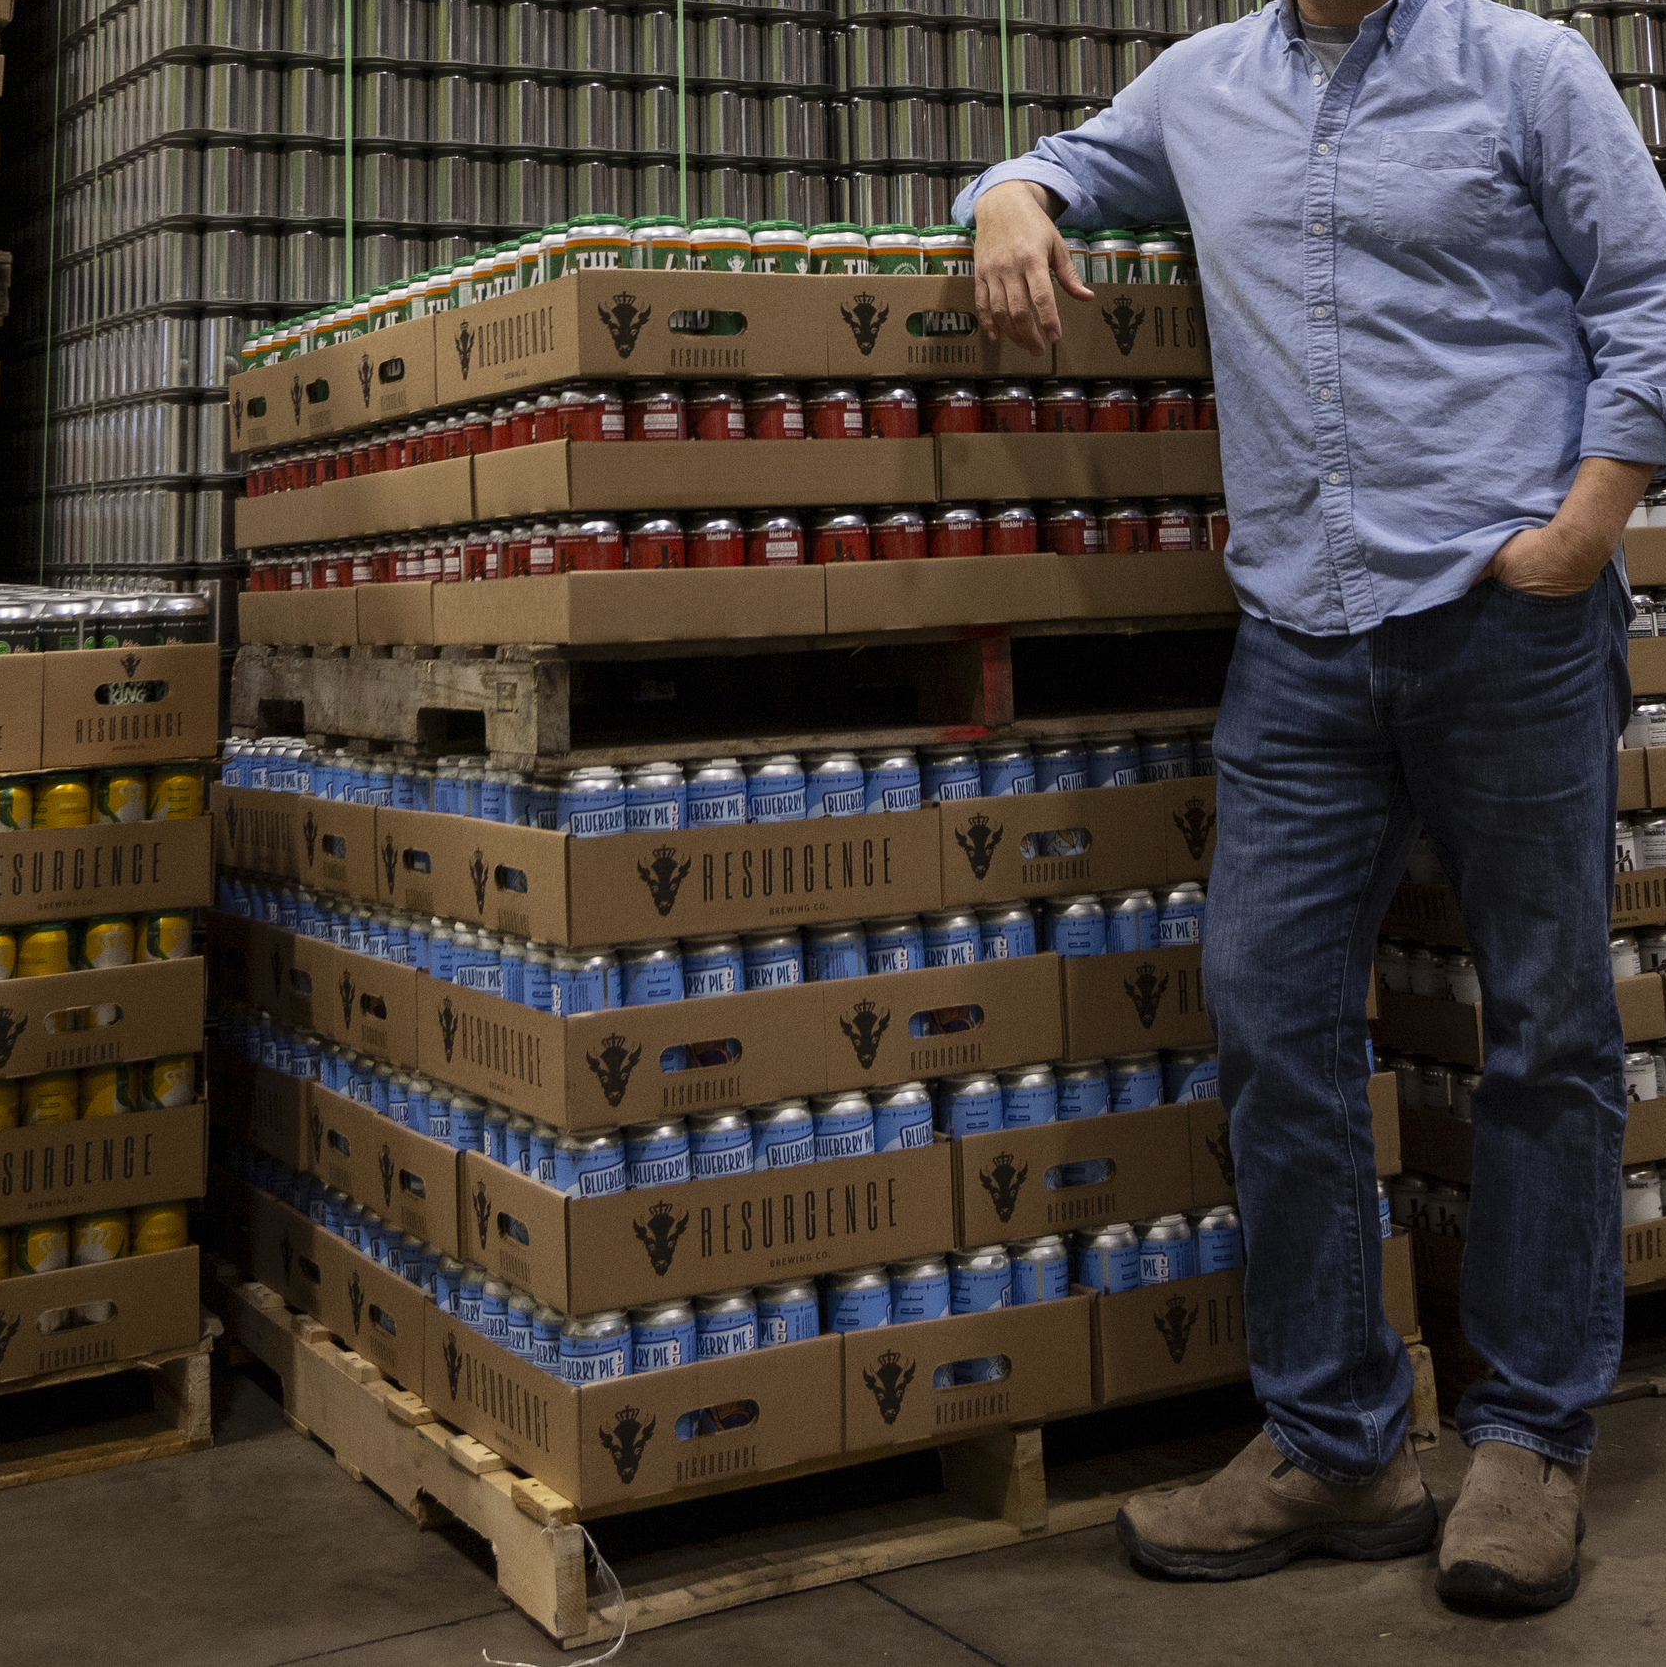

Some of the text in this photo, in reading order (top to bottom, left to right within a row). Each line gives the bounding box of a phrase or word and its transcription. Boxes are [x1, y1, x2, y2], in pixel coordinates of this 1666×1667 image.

[478, 305, 554, 369] RESURGENCE
[671, 349, 747, 368] RESURGENCE
[908, 345, 976, 364] RESURGENCE
[647, 402, 672, 411] blackbird
[769, 530, 793, 539] blackbird
[948, 522, 972, 530] blackbird
[999, 520, 1023, 529] blackbird
[706, 532, 731, 541] blackbird
[108, 687, 146, 705] KING
[76, 712, 184, 744] RESURGENCE
[655, 806, 669, 825] PIE
[727, 800, 740, 817] PIE
[702, 838, 892, 902] RESURGENCE
[1022, 859, 1091, 884] RESURGENCE
[769, 904, 810, 916] BREWING
[1176, 922, 1190, 939] PIE
[883, 953, 897, 970] PIE
[951, 946, 966, 964] PIE
[709, 973, 723, 993] PIE
[777, 967, 792, 985] PIE
[45, 1040, 122, 1069] RESURGENCE
[462, 1012, 542, 1088] RESURGENCE
[910, 1043, 982, 1071] RESURGENCE
[663, 1076, 741, 1108] RESURGENCE
[694, 1153, 745, 1175] BLUEBERRY
[701, 1178, 897, 1258] RESURGENCE
[1048, 1193, 1116, 1224] RESURGENCE
[769, 1251, 832, 1268] BREWING CO.
[1143, 1257, 1158, 1276] PIE
[732, 1330, 747, 1350] PIE
[759, 1320, 776, 1344] PIE
[656, 1347, 669, 1367] PIE
[599, 1357, 614, 1378] PIE
[465, 1353, 550, 1453] RESURGENCE
[935, 1391, 1011, 1425] RESURGENCE
[676, 1445, 757, 1482] RESURGENCE
